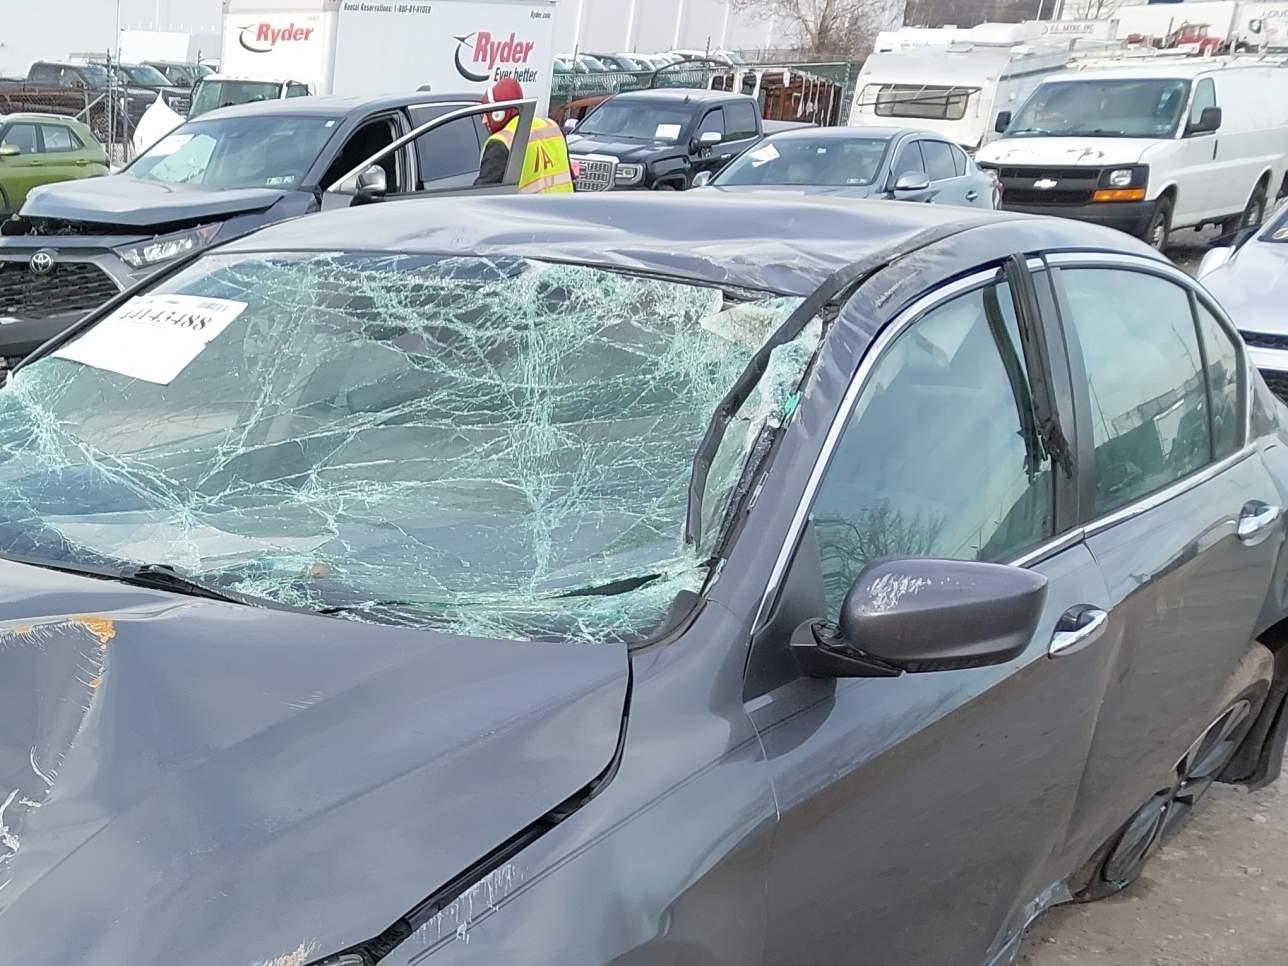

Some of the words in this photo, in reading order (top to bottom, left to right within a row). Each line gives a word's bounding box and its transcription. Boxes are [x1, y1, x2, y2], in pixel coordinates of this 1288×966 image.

[343, 3, 360, 11] Rental
[255, 22, 314, 47] Ryder
[473, 31, 534, 70] Ryder
[494, 67, 512, 81] Ever
